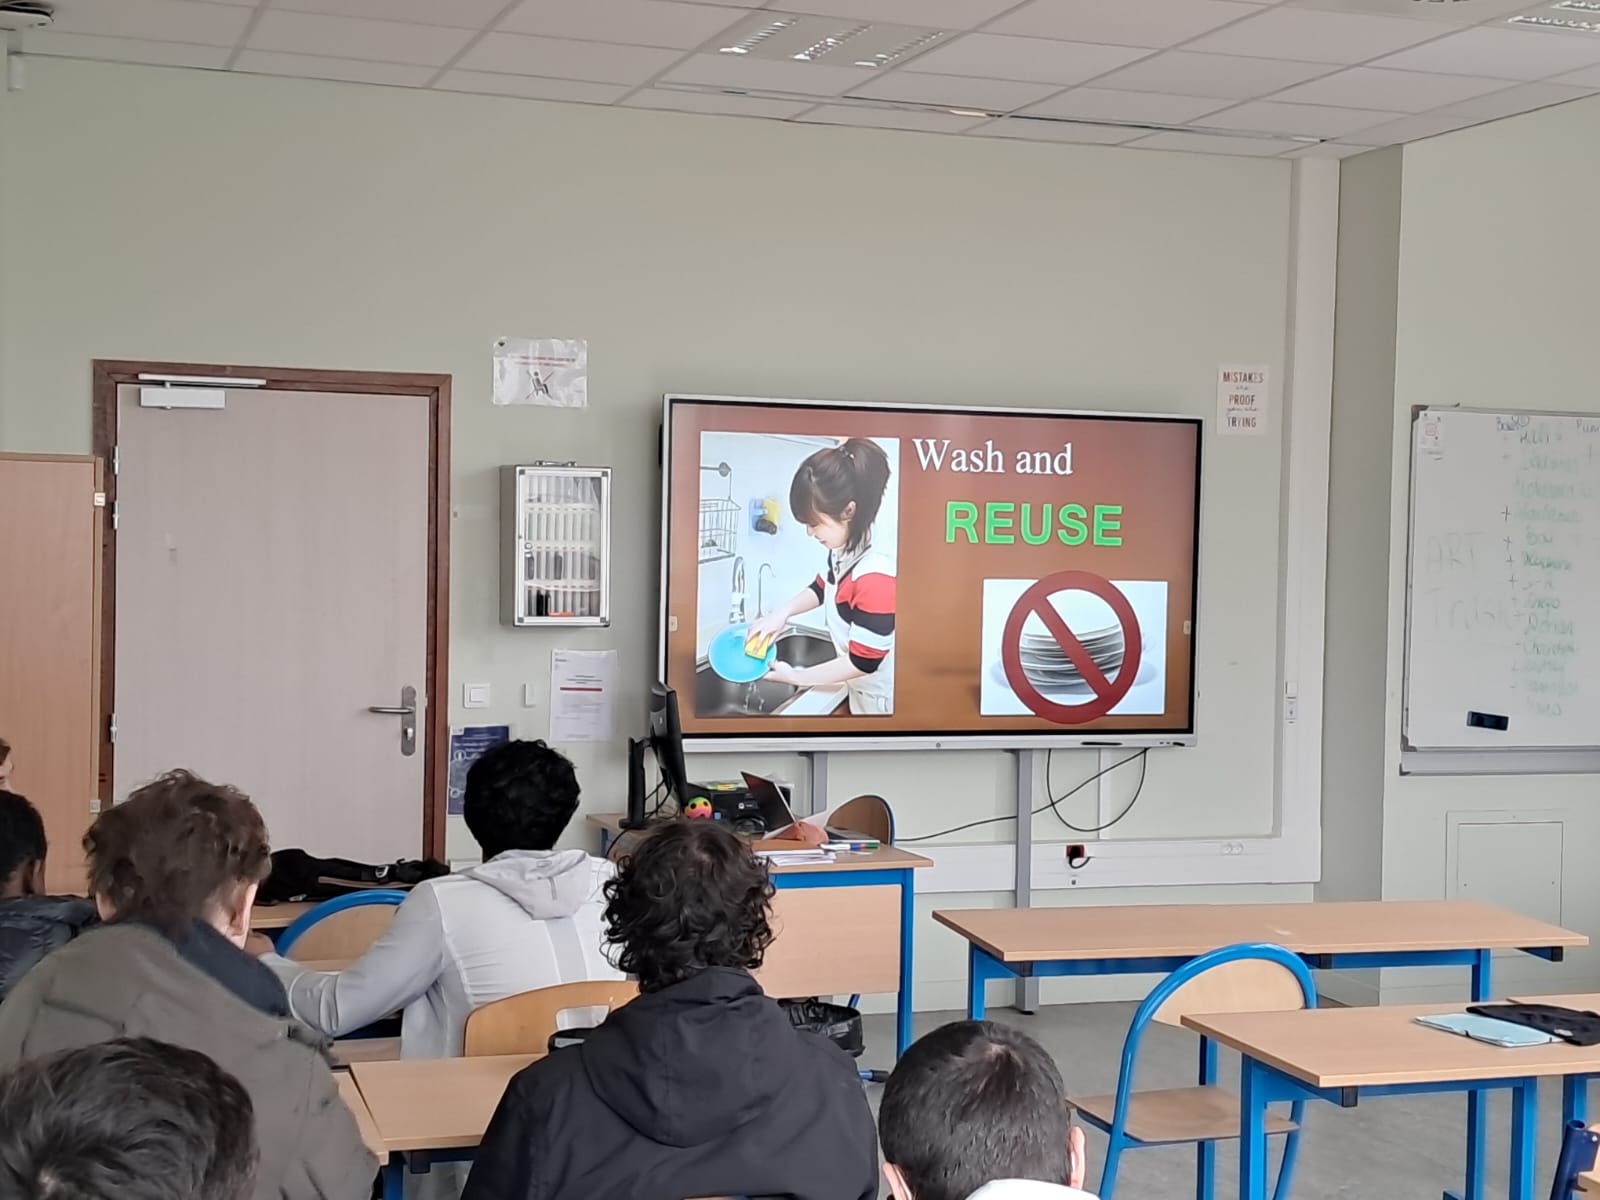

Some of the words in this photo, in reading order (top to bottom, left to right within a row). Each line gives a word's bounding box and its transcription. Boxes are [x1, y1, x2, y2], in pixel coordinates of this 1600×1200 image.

[1223, 371, 1264, 384] MISTAKES
[1228, 394, 1256, 406] PROOF
[1227, 416, 1257, 428] TRYING
[912, 438, 1005, 473] Wash
[1015, 442, 1073, 475] and
[945, 501, 1123, 546] REUSE
